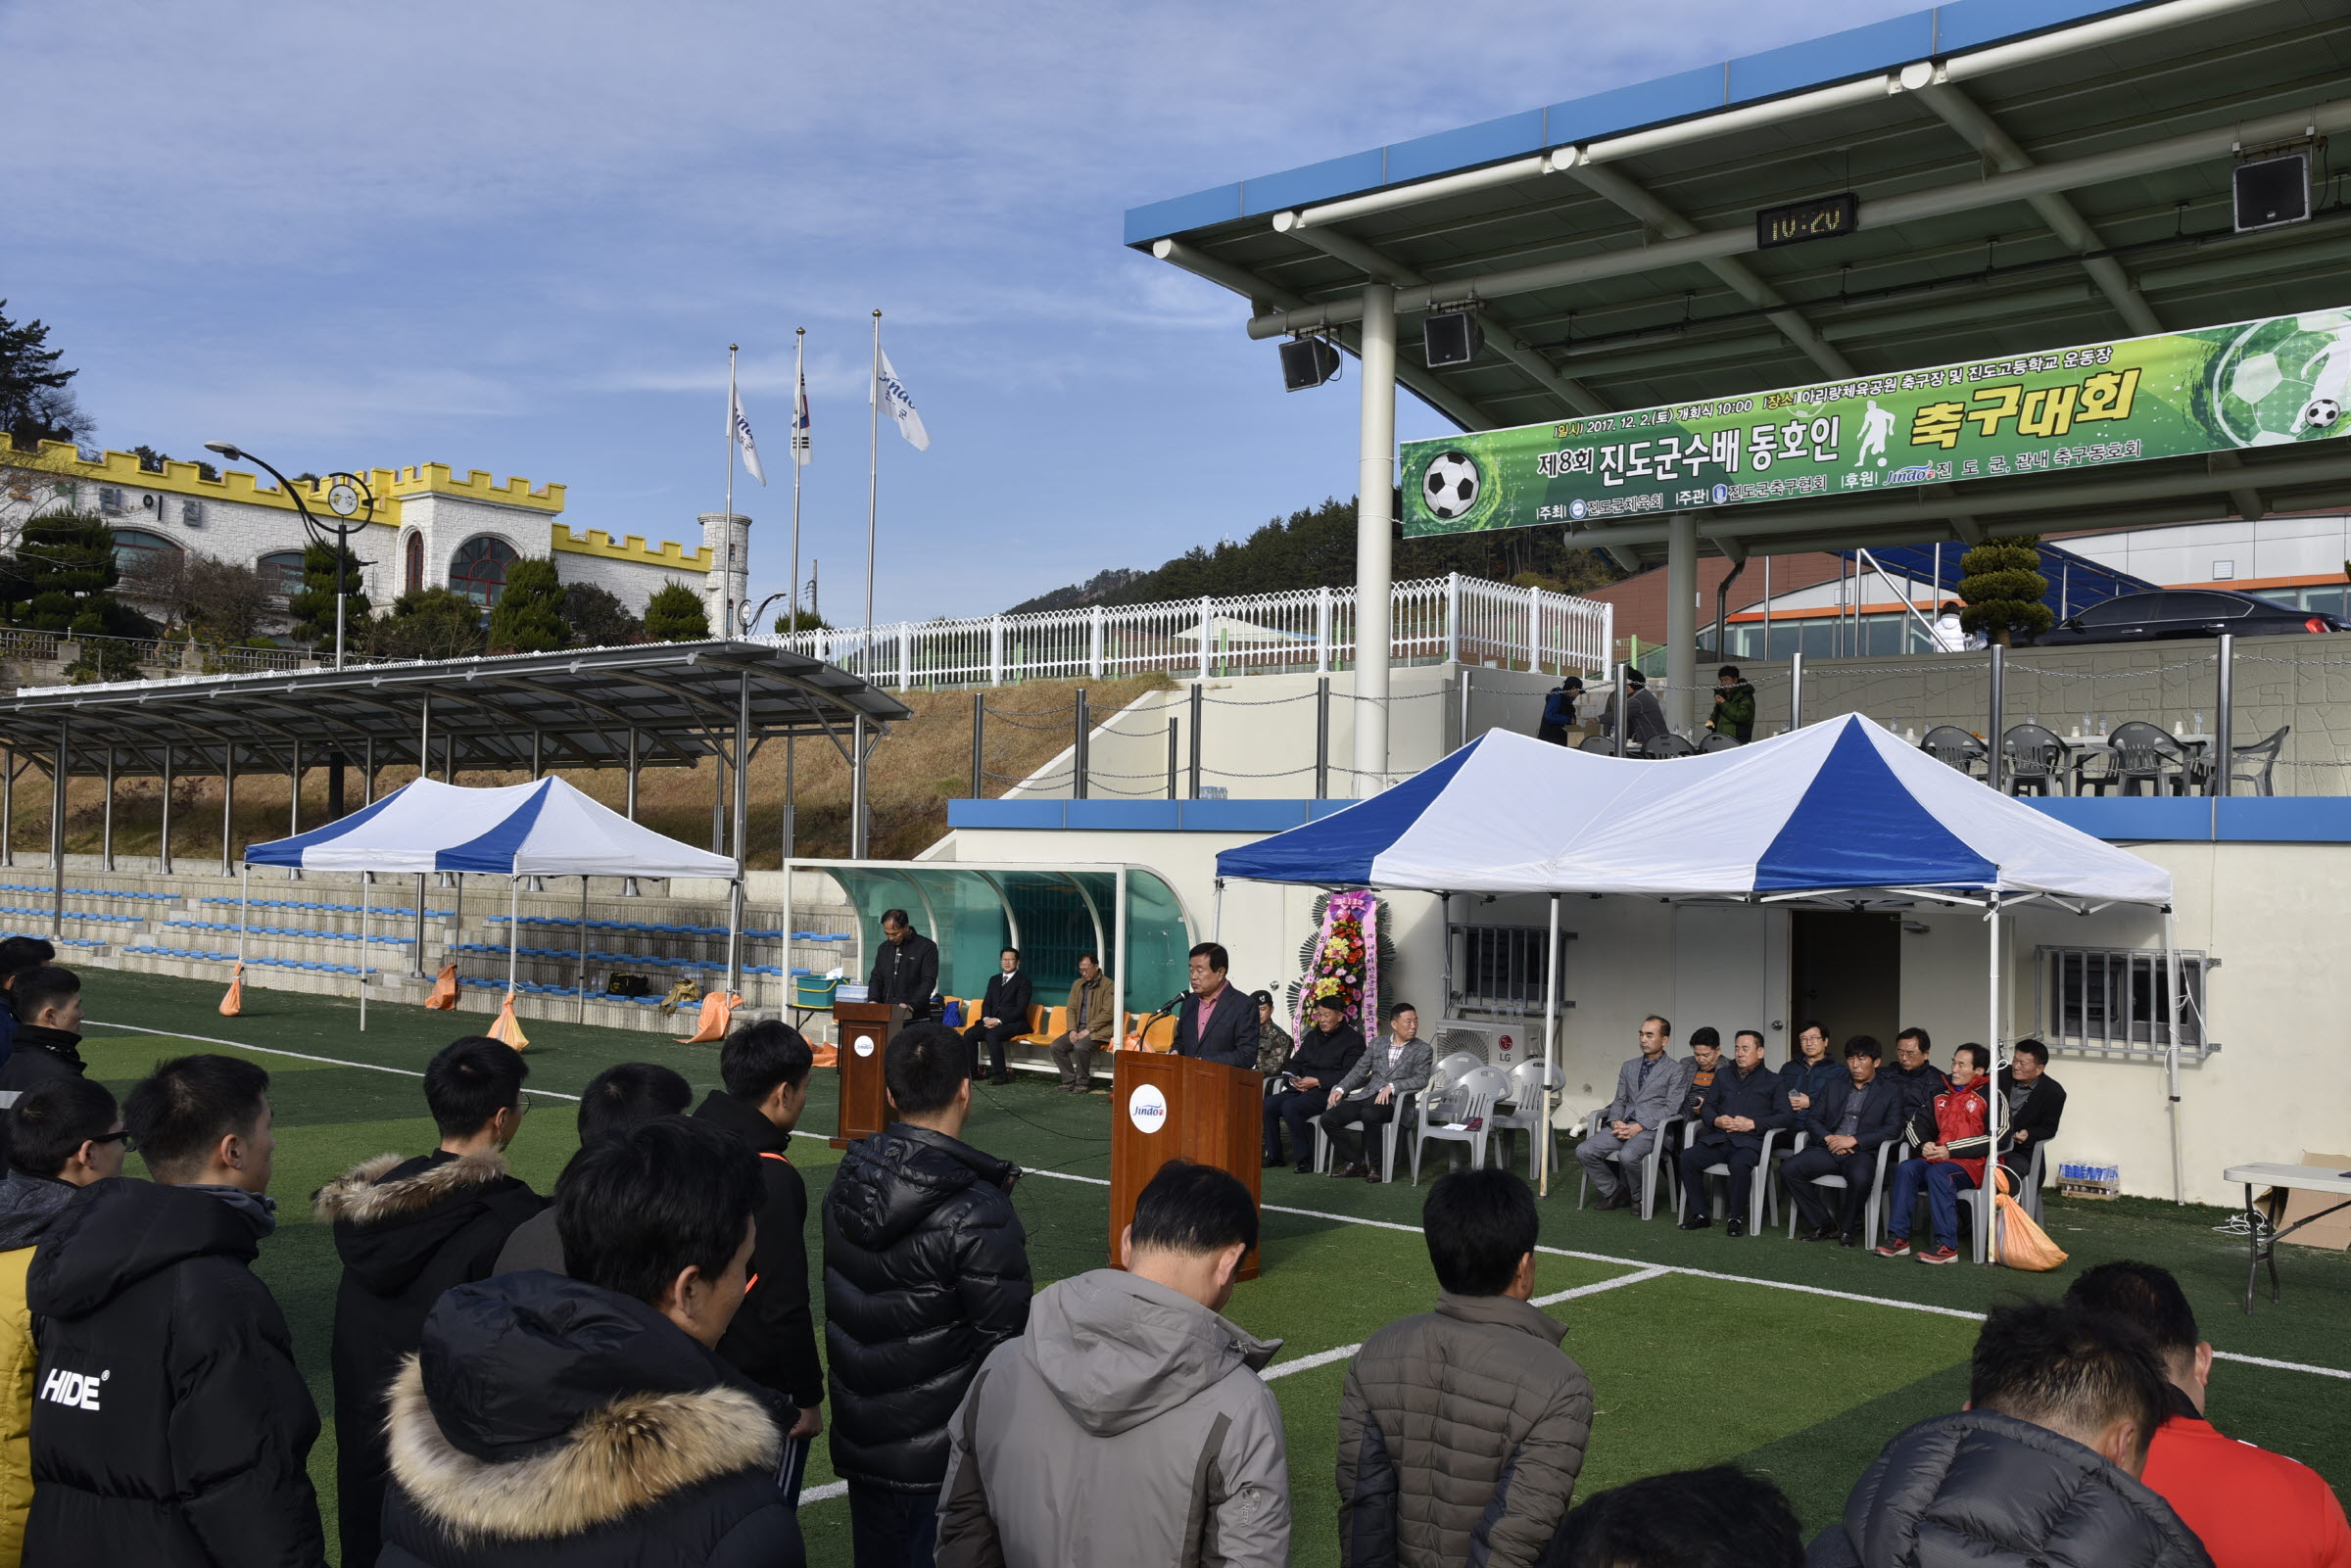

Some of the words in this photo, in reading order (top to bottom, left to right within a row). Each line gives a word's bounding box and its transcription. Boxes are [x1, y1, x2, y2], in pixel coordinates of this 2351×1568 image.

[1587, 418, 1616, 433] 2017.
[1621, 416, 1636, 429] 12.
[1676, 403, 1713, 420] 개회식
[1718, 400, 1753, 415] 10:00
[1802, 377, 1897, 403] 아리랑체육공원
[1901, 371, 1945, 390] 축구장
[1949, 368, 1963, 383] 및
[1969, 356, 2057, 380] 진도고등학교
[2063, 347, 2112, 367] 운동장
[1536, 447, 1594, 478] 제8회
[1599, 428, 1741, 487] 진도군수배
[1748, 416, 1840, 471] 동호인
[1911, 368, 2140, 449] 축구대회
[1587, 493, 1663, 516] 진도군체육회
[1728, 474, 1827, 500] 진도군축구협회
[1883, 470, 1926, 486] Jindo
[2016, 451, 2049, 470] 관내
[2054, 439, 2141, 465] 축구동호회
[1499, 1053, 1511, 1063] LG
[1132, 1106, 1159, 1117] Jindo
[40, 1368, 100, 1410] HIDE
